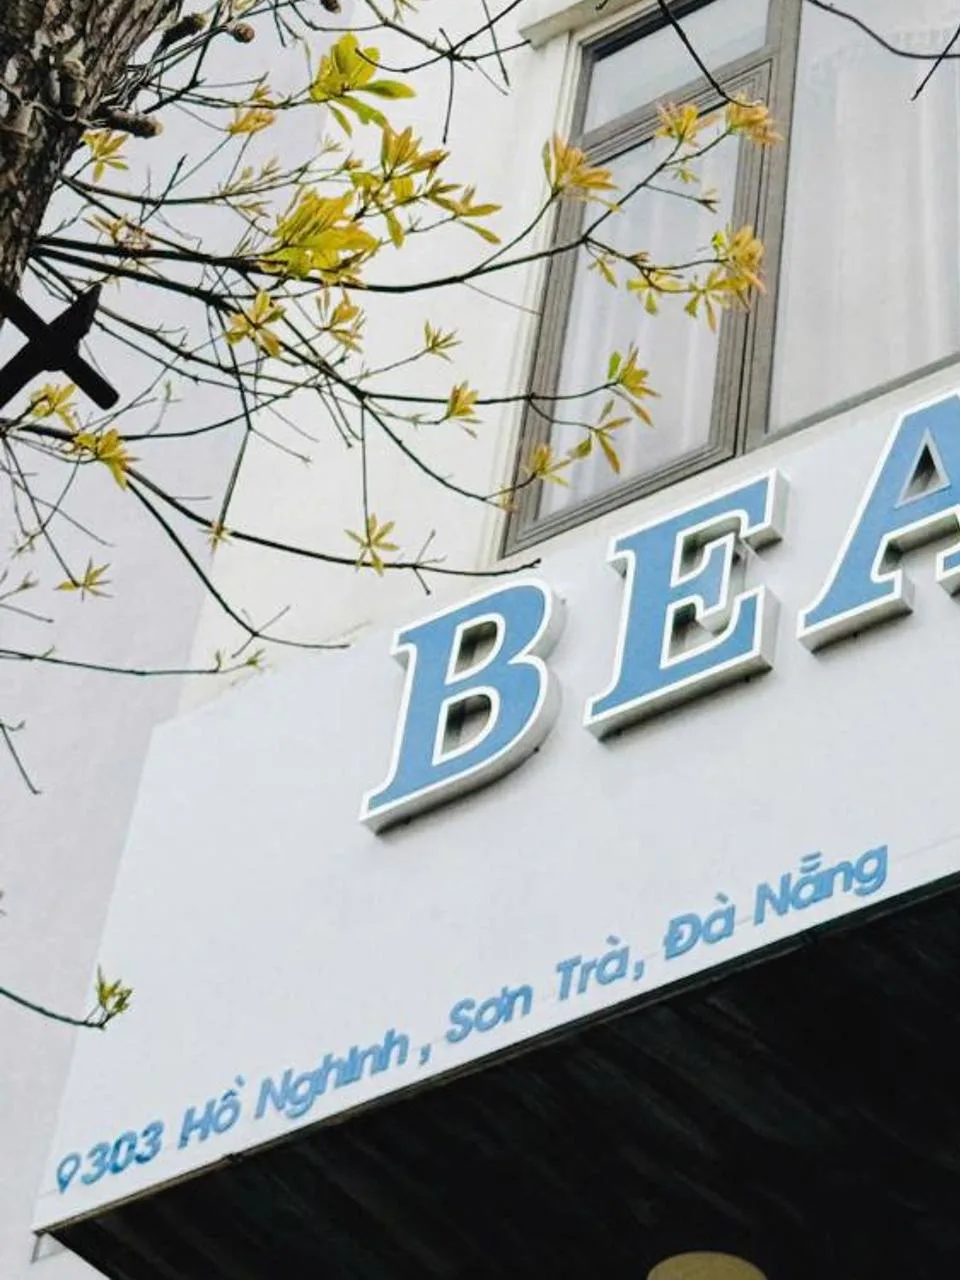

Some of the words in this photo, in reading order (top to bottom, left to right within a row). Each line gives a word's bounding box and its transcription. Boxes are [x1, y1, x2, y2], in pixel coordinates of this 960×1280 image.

[81, 1120, 166, 1186] 303
[178, 1074, 247, 1150] Hồ
[444, 982, 534, 1045] Sơn
[556, 934, 645, 1003] Trà,
[663, 891, 737, 961] Đà
[752, 843, 889, 927] Nẵng
